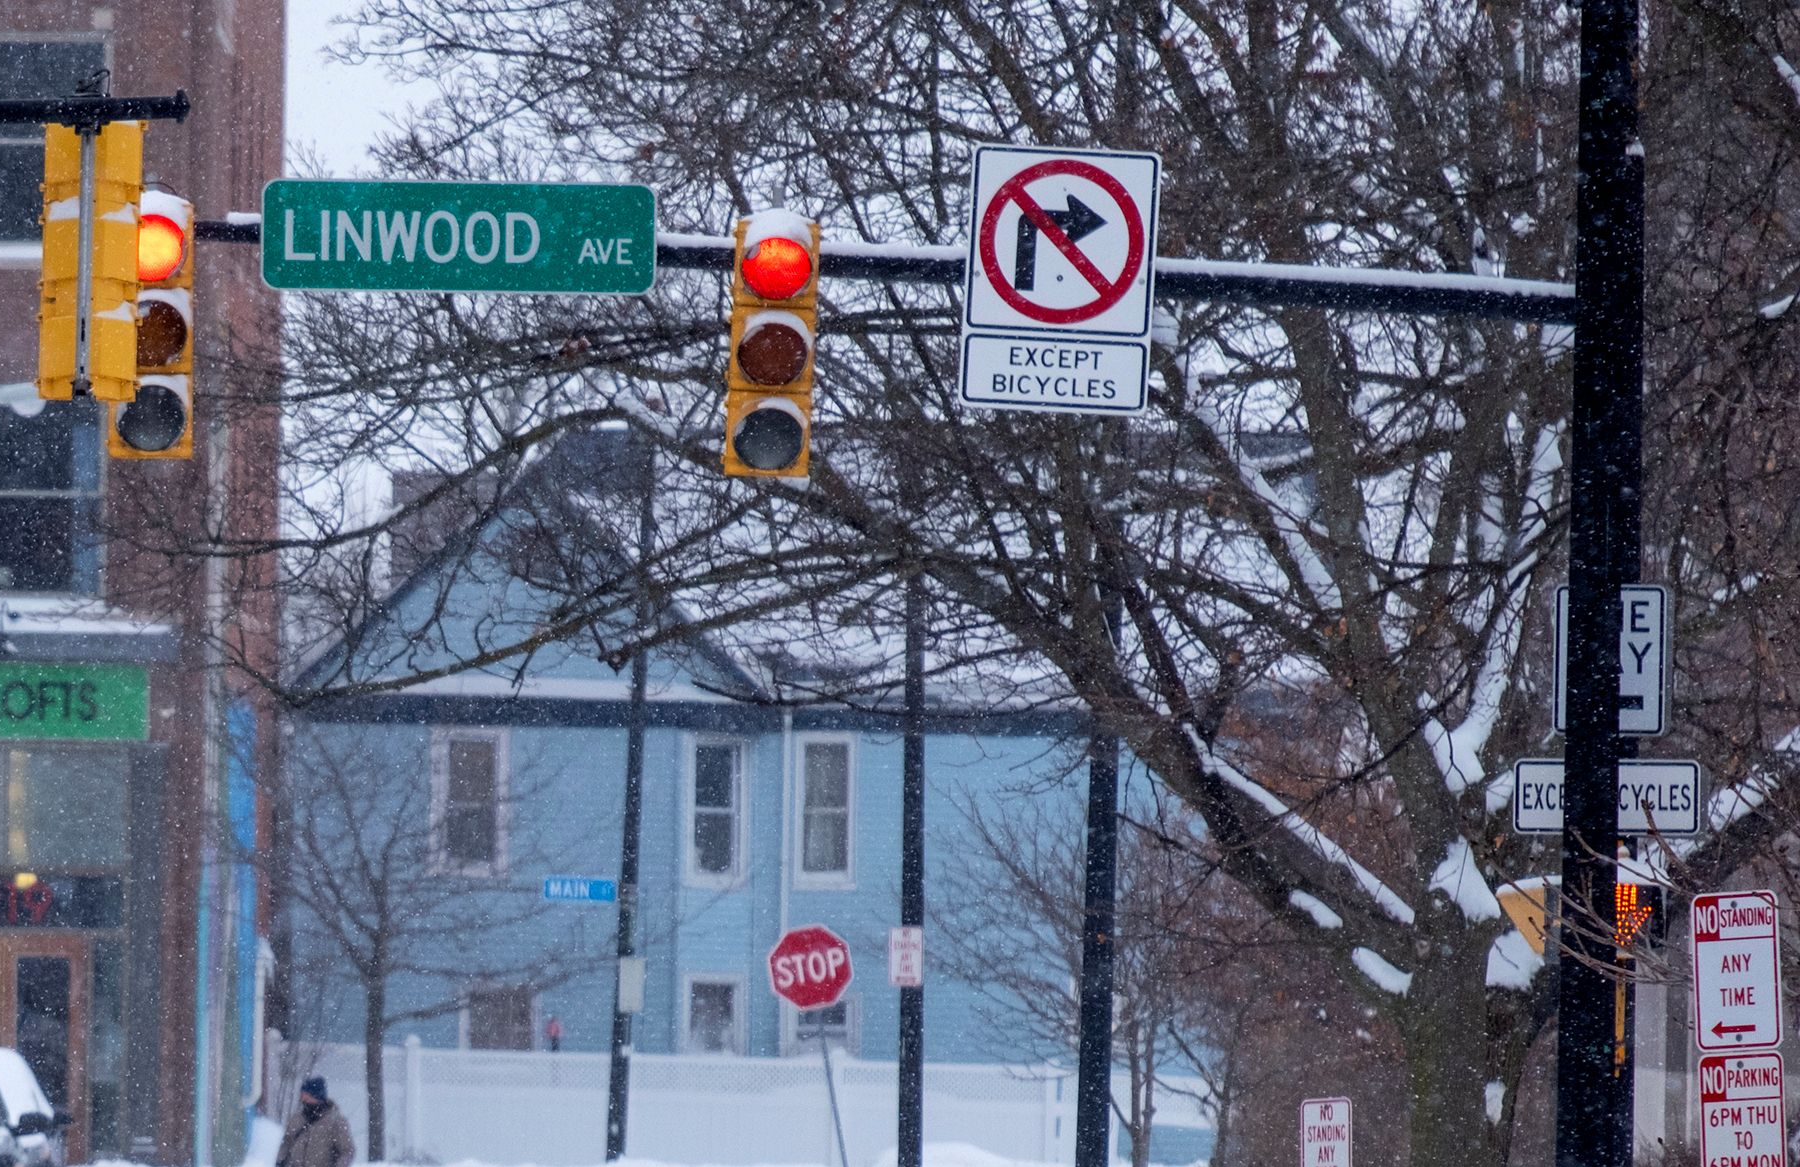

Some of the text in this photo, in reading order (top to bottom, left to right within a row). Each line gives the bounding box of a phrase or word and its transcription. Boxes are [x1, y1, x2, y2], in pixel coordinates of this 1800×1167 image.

[284, 208, 634, 265] LINWOOD AVE
[1009, 346, 1104, 370] EXCEPT
[992, 373, 1117, 400] BICYCLES
[1619, 784, 1691, 811] CYCLES
[549, 880, 590, 898] MAIN
[1695, 905, 1772, 935] NO STANDING
[776, 947, 846, 989] STOP
[1720, 953, 1752, 974] ANY
[1720, 986, 1756, 1007] TIME
[1701, 1065, 1779, 1095] NO PARKING
[1320, 1104, 1334, 1121] NO
[1710, 1105, 1778, 1127] 6PM THU
[1307, 1124, 1346, 1143] STANDING
[1734, 1131, 1753, 1150] TO
[1318, 1145, 1336, 1162] ANY
